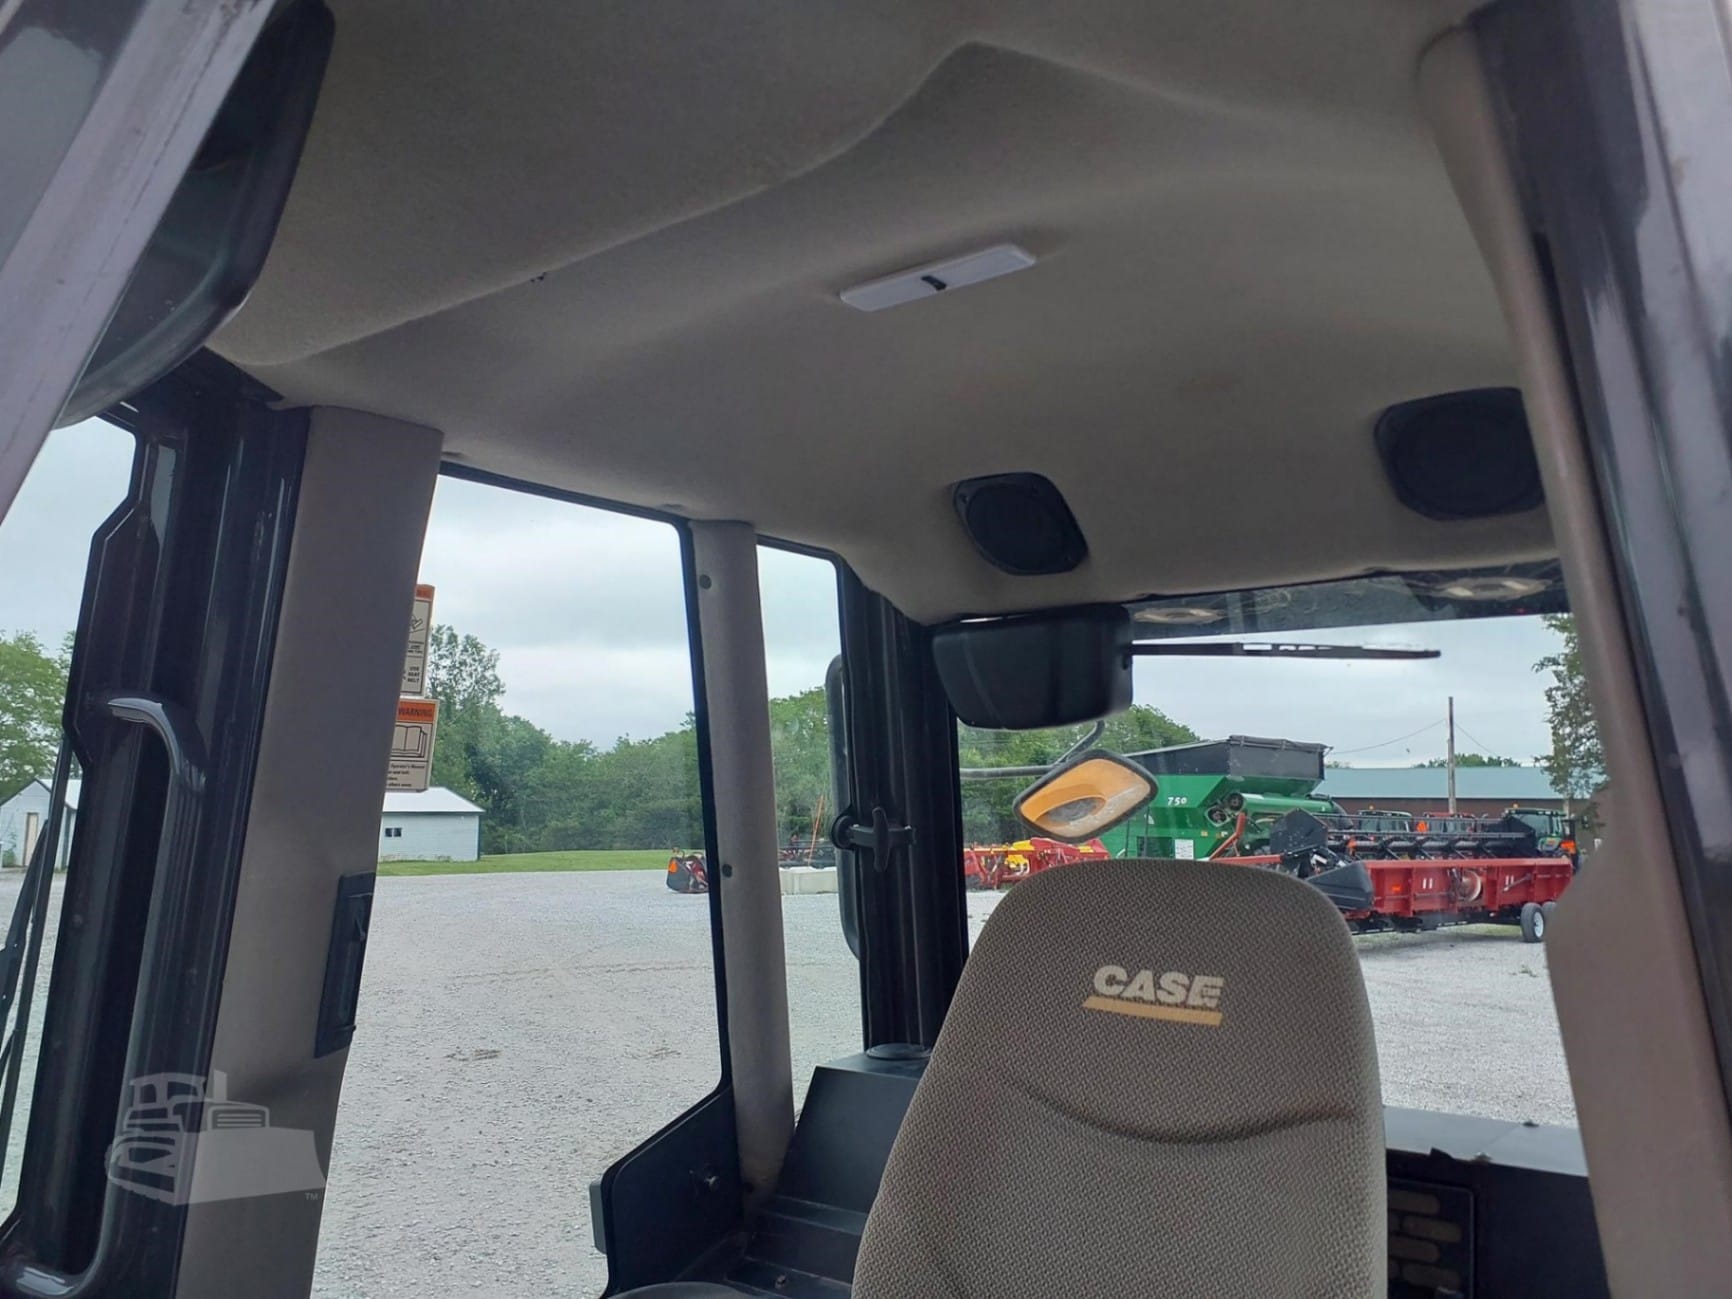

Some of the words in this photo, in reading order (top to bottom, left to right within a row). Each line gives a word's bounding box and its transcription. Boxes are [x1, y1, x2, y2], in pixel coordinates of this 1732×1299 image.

[398, 707, 433, 717] WARNING
[1167, 796, 1187, 806] 750
[1093, 965, 1225, 1008] CASE
